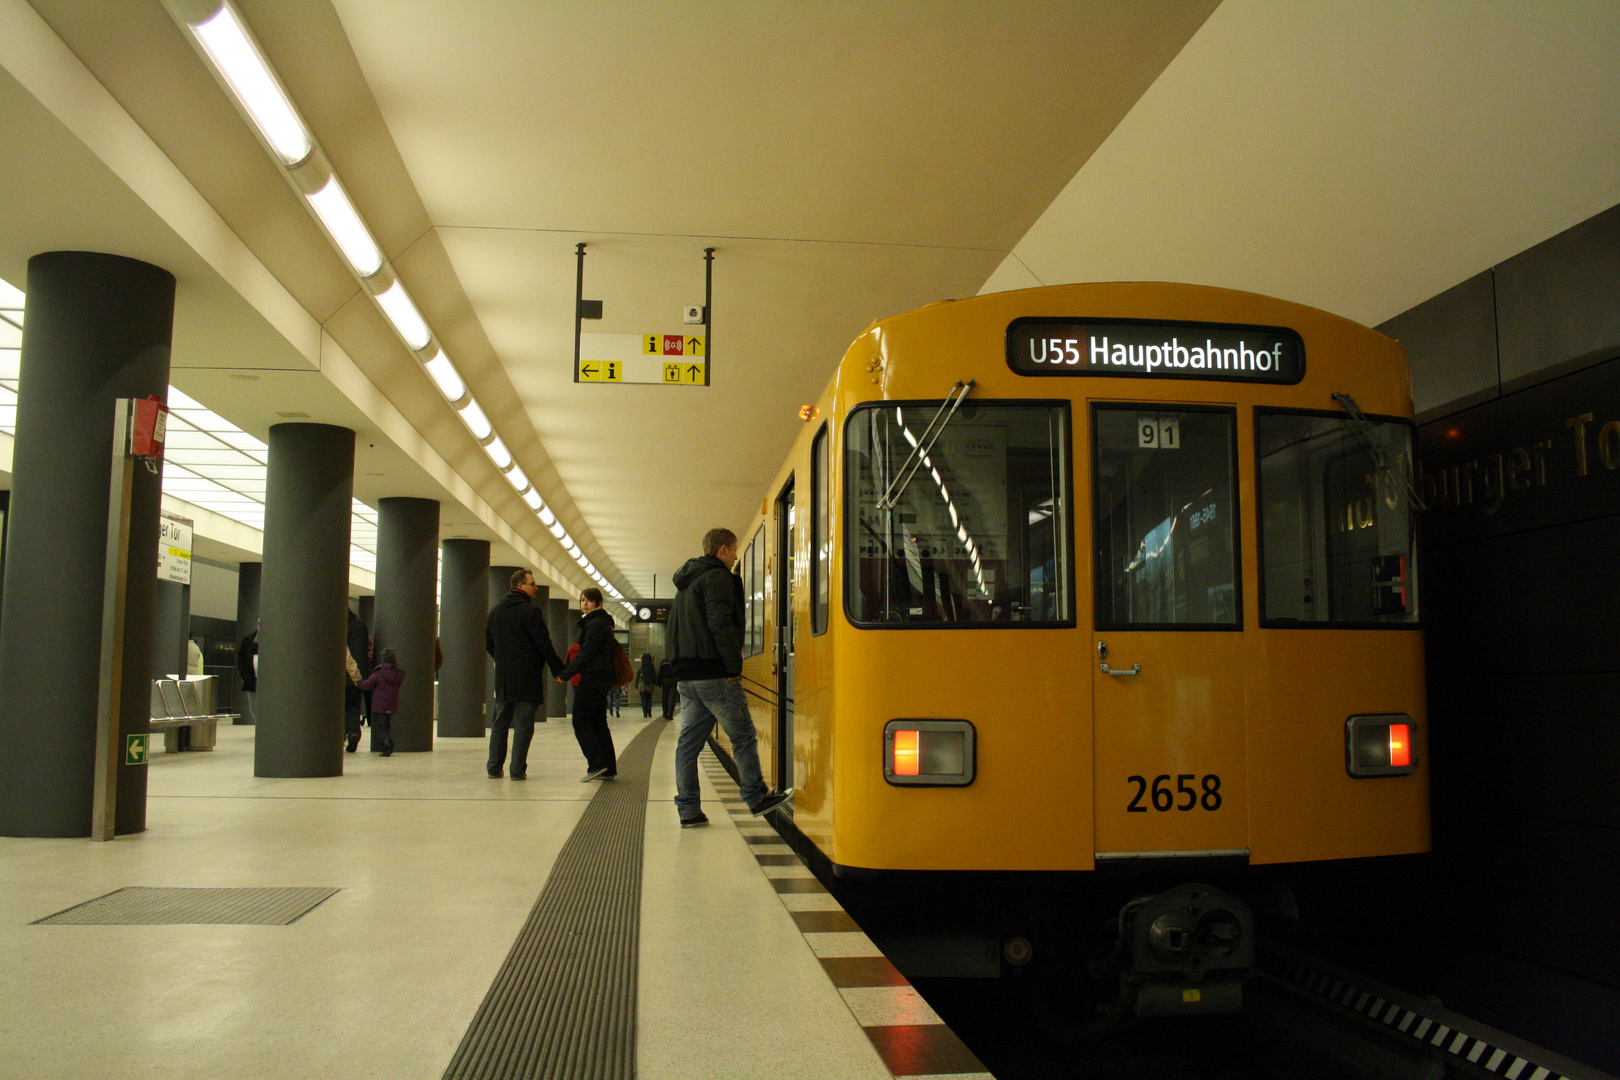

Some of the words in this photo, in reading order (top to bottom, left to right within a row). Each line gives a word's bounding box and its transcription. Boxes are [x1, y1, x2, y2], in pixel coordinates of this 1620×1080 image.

[1029, 337, 1080, 365] U55
[1090, 335, 1282, 372] Hauptbahnhof
[1141, 424, 1174, 445] 91
[1127, 774, 1222, 812] 2658
